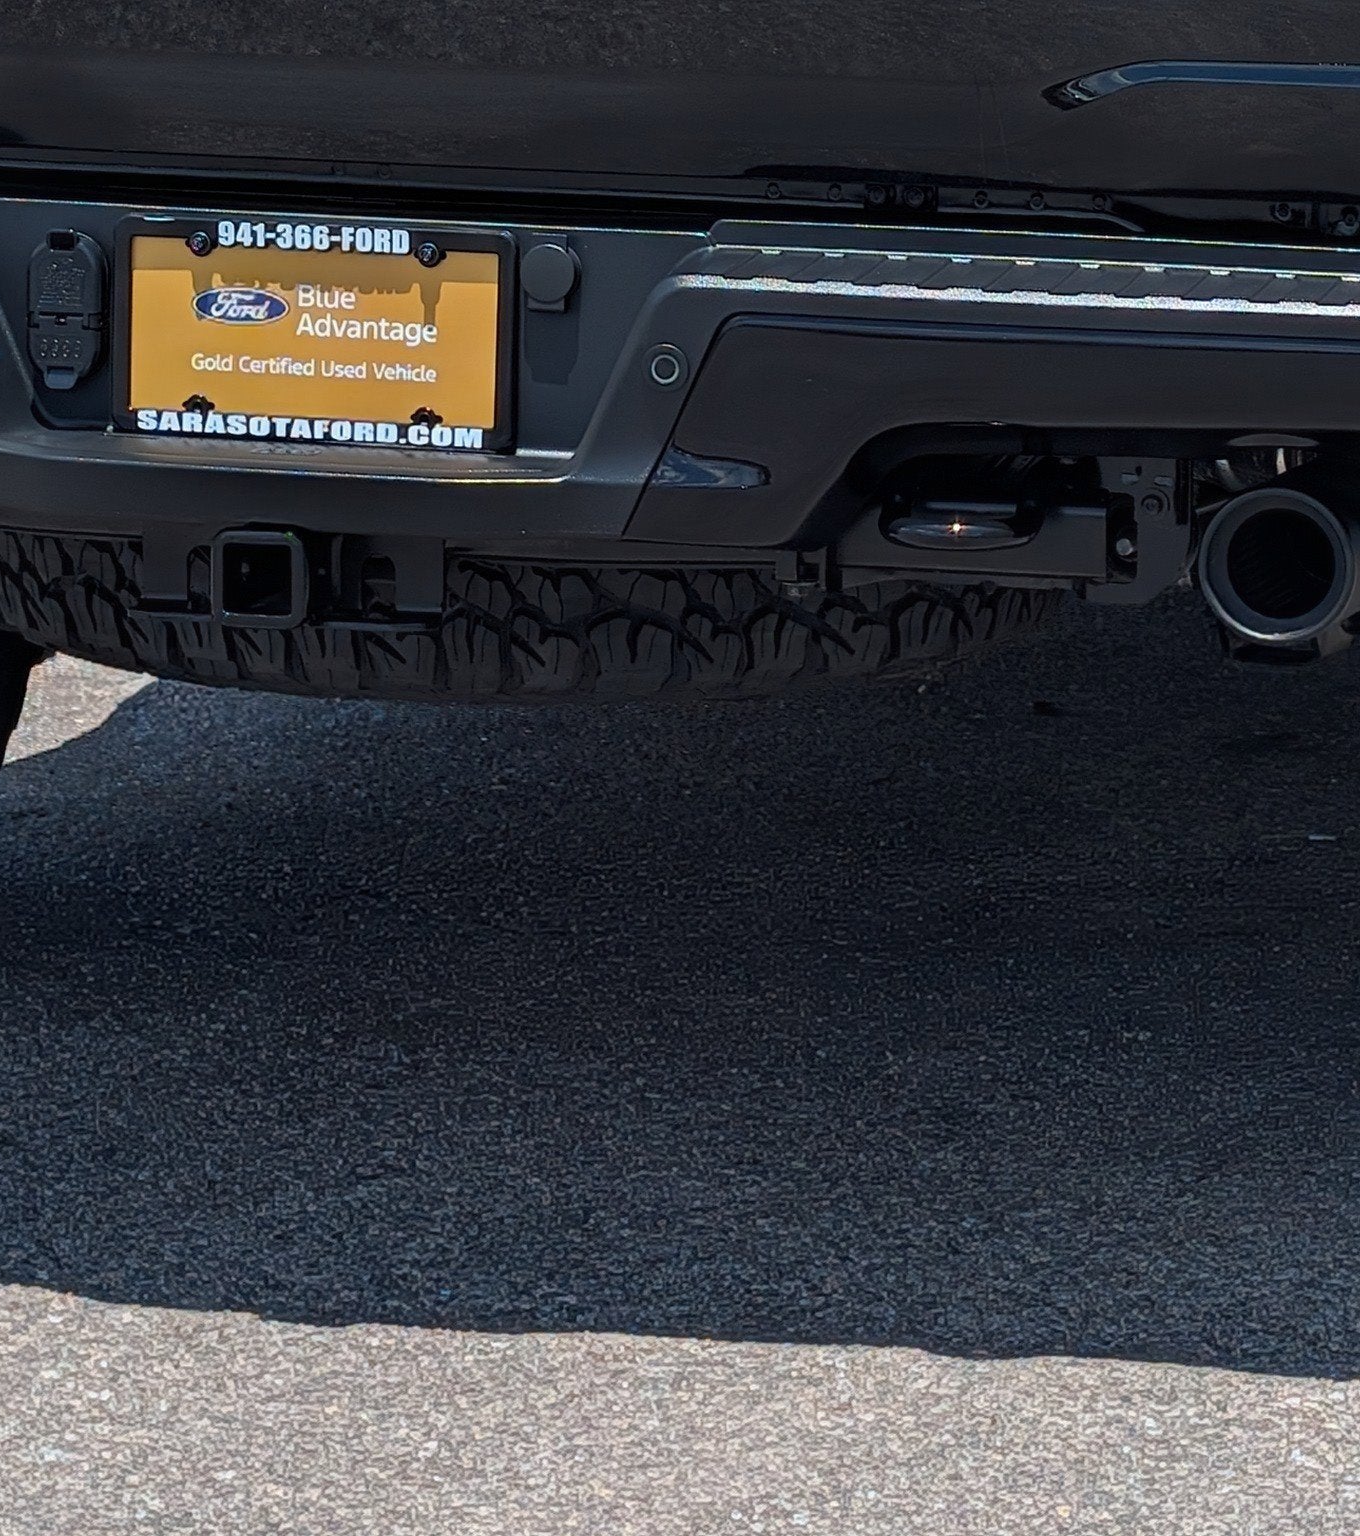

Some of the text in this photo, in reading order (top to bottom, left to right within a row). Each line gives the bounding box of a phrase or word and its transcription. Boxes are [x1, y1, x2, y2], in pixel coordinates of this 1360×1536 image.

[217, 220, 411, 255] 941-366-FORD
[210, 292, 270, 320] Ford
[296, 284, 356, 310] Blue
[295, 313, 438, 347] Advantage
[190, 352, 437, 383] Gold Certified Used Vehicle
[136, 410, 483, 449] SARASOTAFORD.COM
